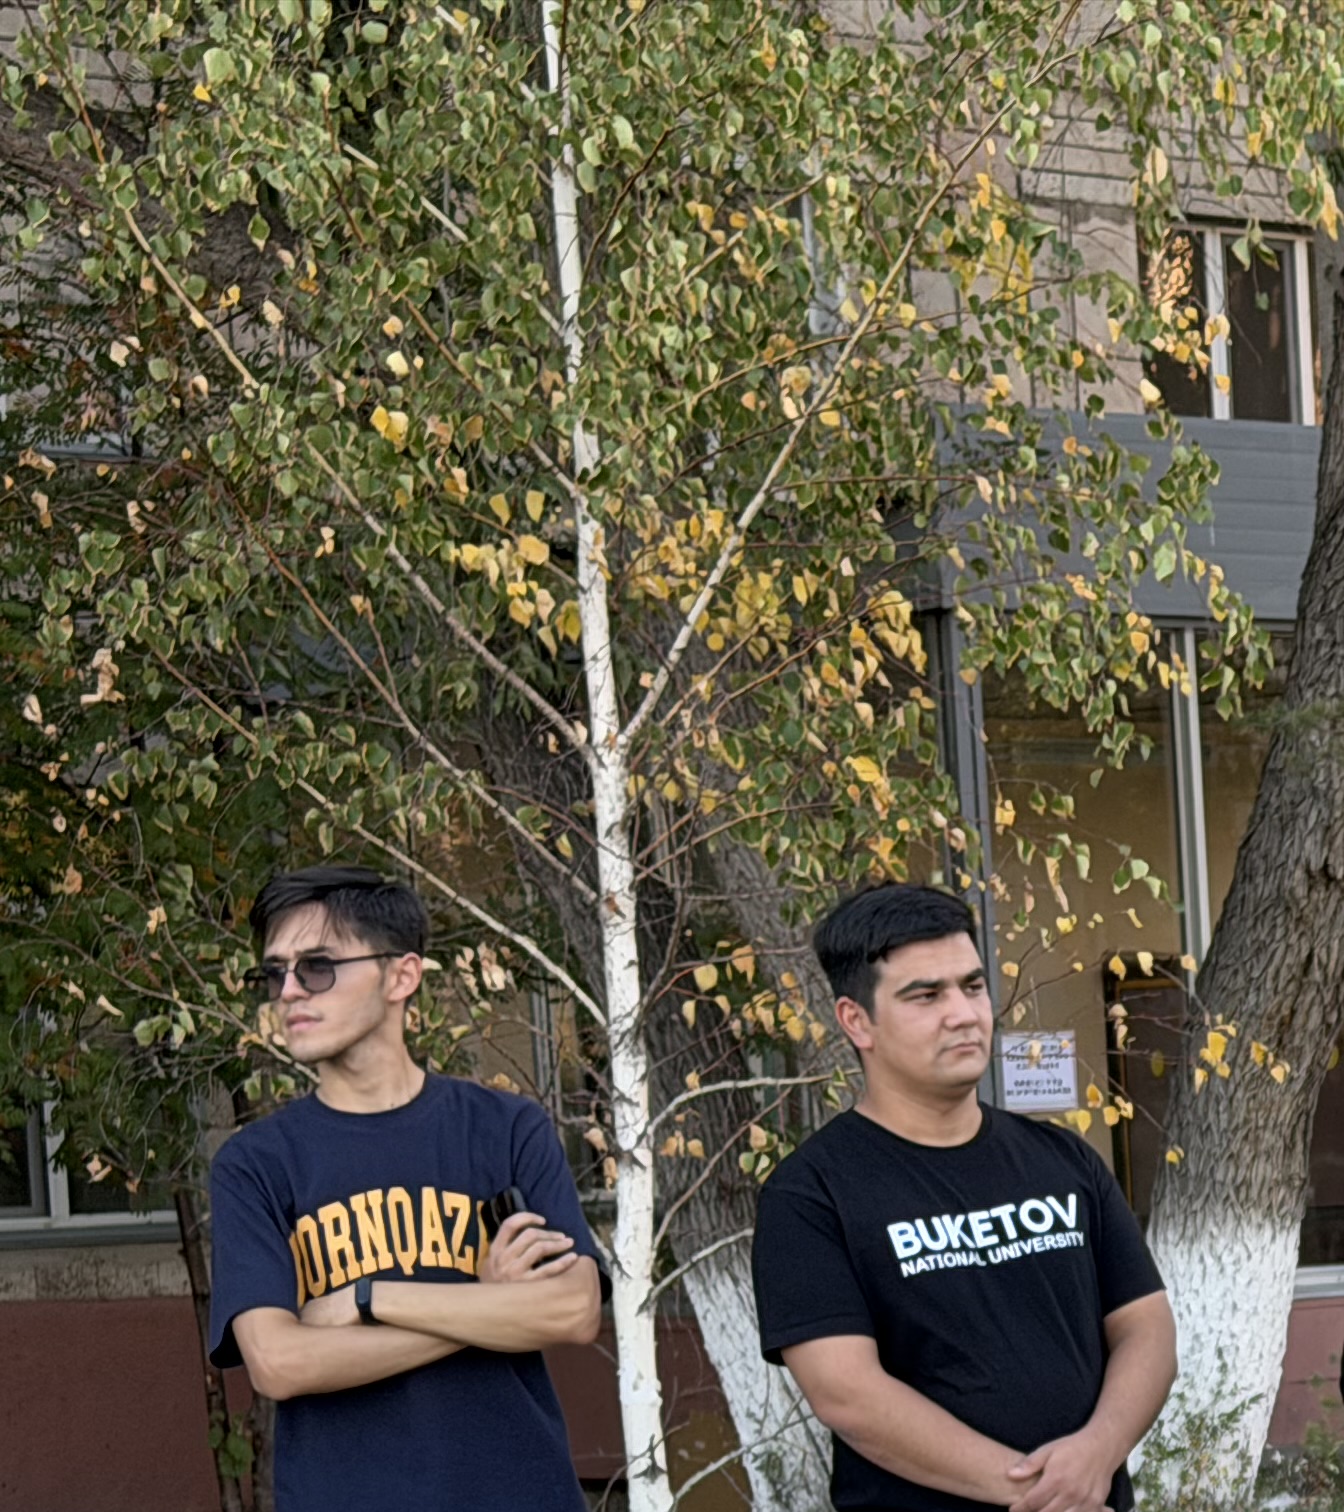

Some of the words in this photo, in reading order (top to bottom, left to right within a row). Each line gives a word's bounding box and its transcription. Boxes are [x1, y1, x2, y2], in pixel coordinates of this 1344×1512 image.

[887, 1193, 1077, 1259] BUKETOV
[900, 1250, 988, 1278] NATIONAL
[987, 1231, 1085, 1264] UNIVERSITY
